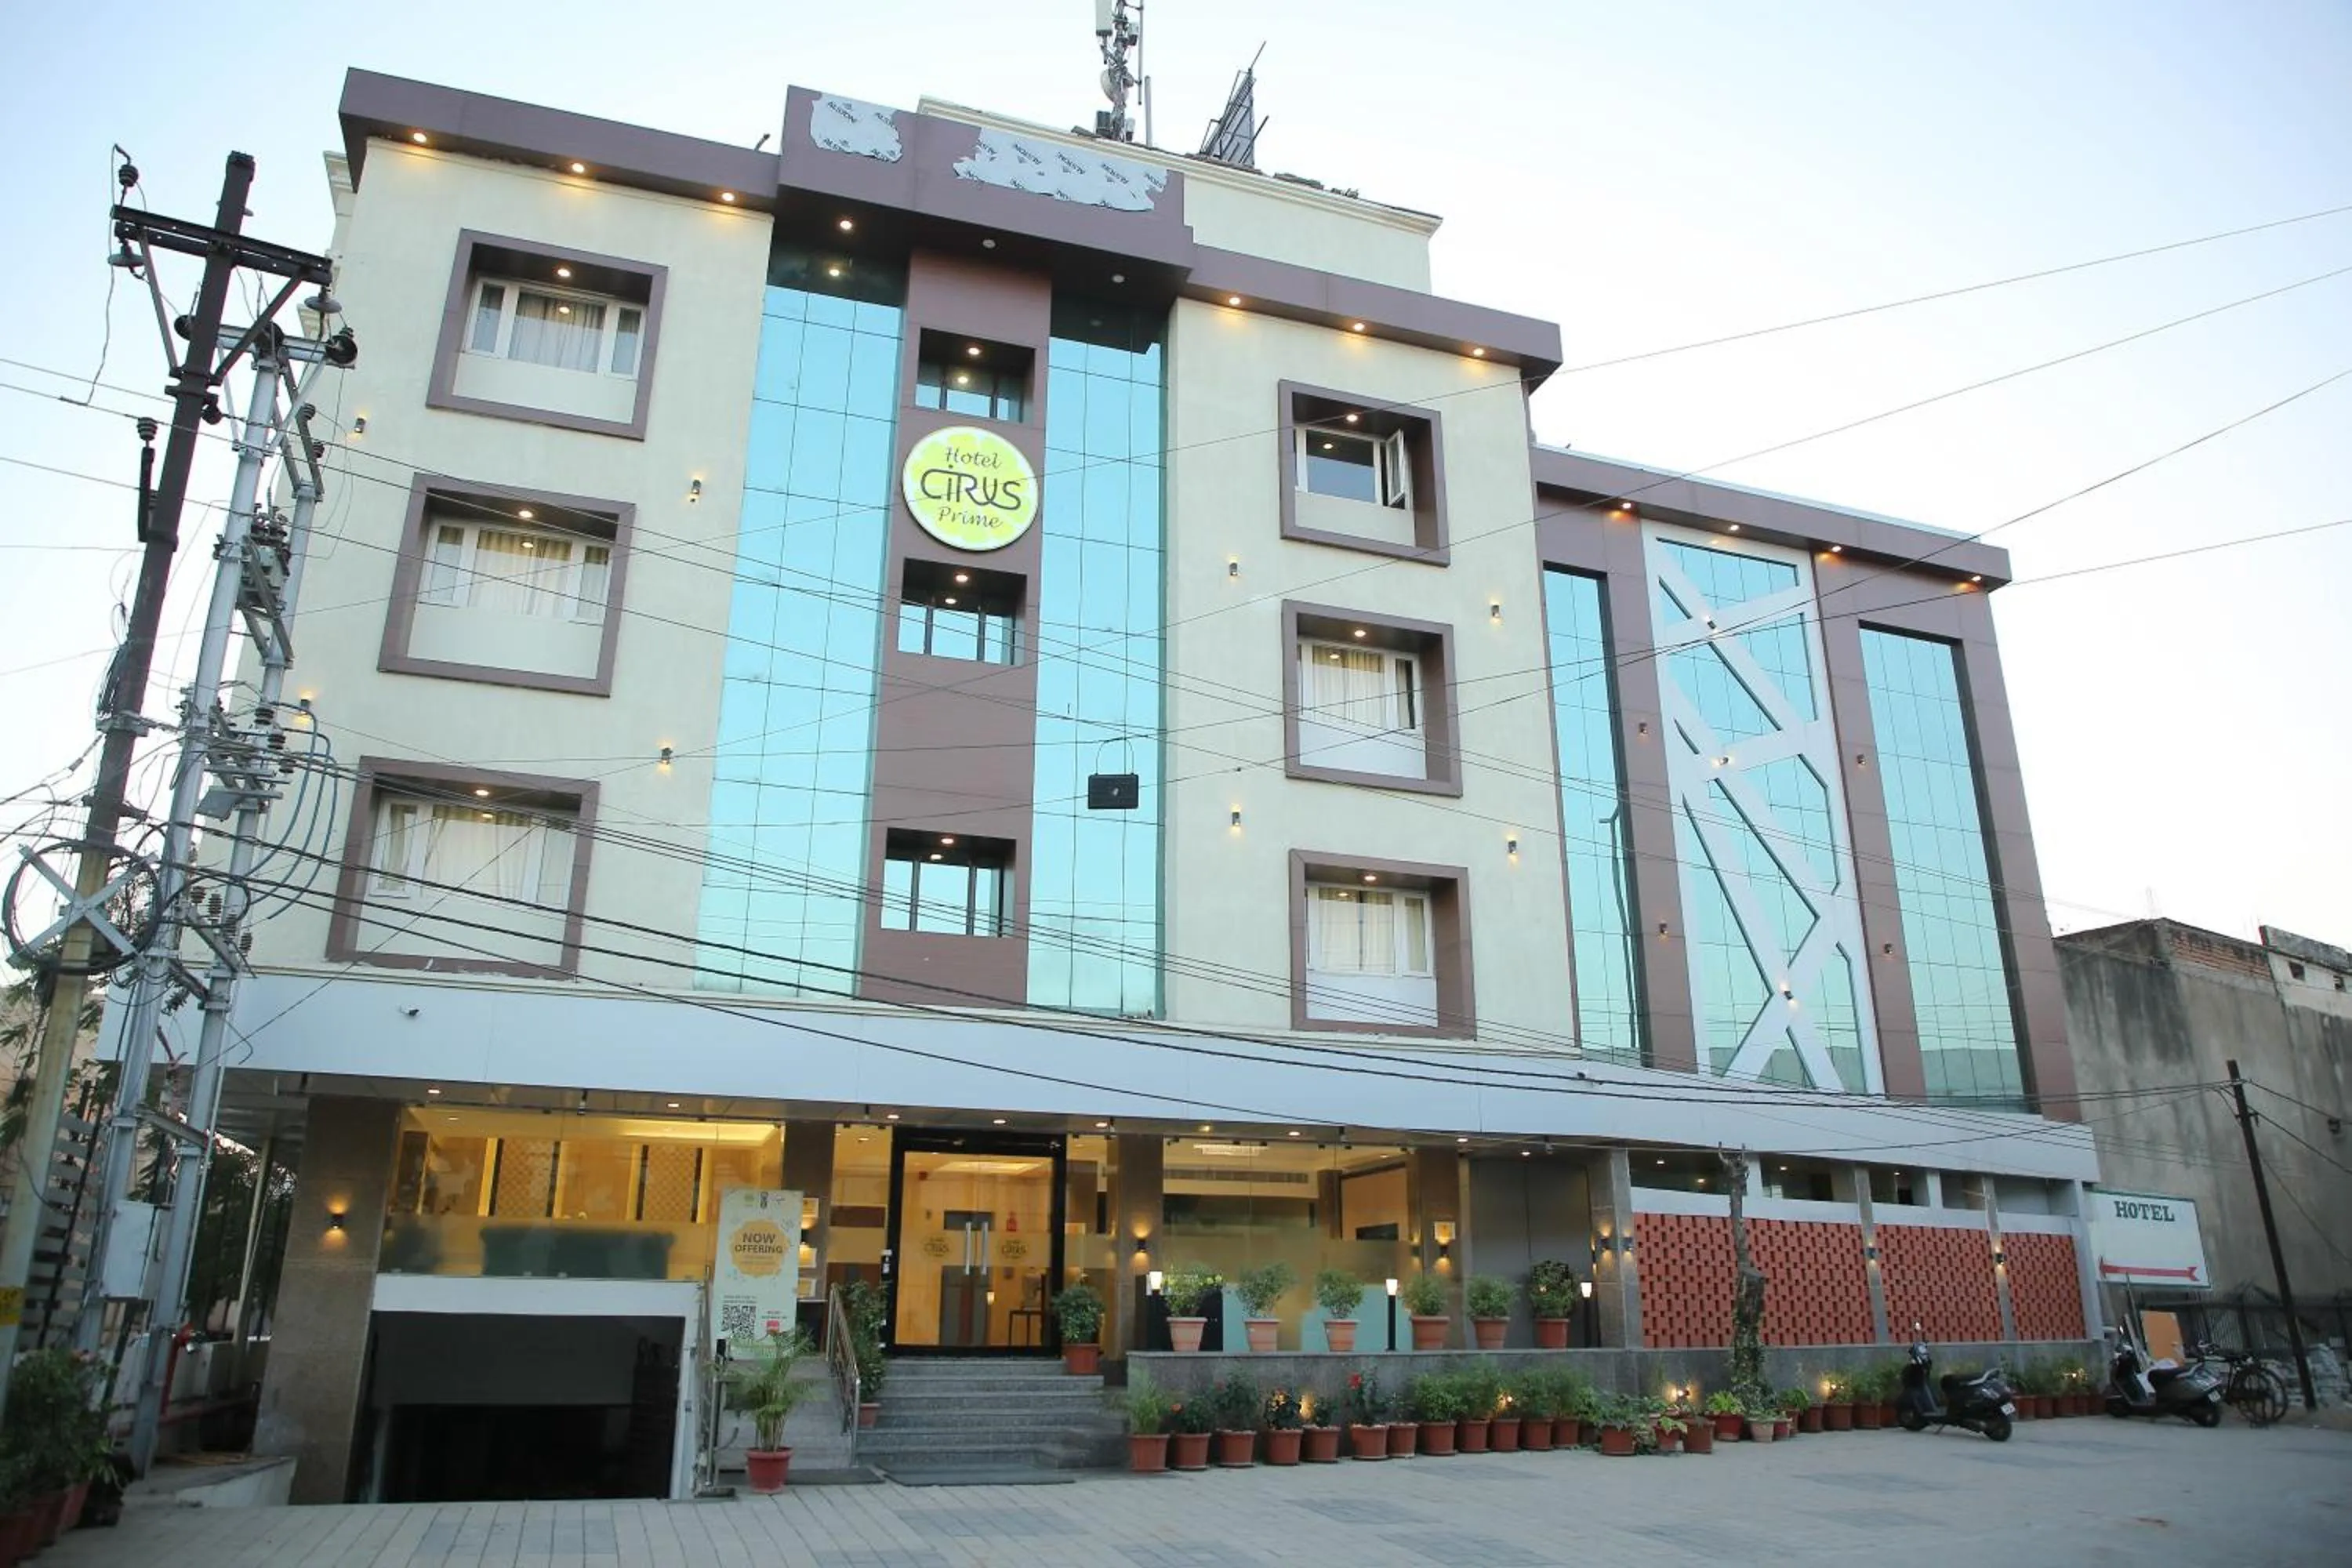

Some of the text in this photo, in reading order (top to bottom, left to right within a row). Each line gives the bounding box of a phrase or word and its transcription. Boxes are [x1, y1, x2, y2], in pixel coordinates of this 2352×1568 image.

[946, 446, 1001, 469] Hotel
[938, 506, 1003, 528] Prime
[2114, 1200, 2175, 1221] HOTEL
[742, 1232, 775, 1243] NOW
[734, 1244, 782, 1254] OFFERING
